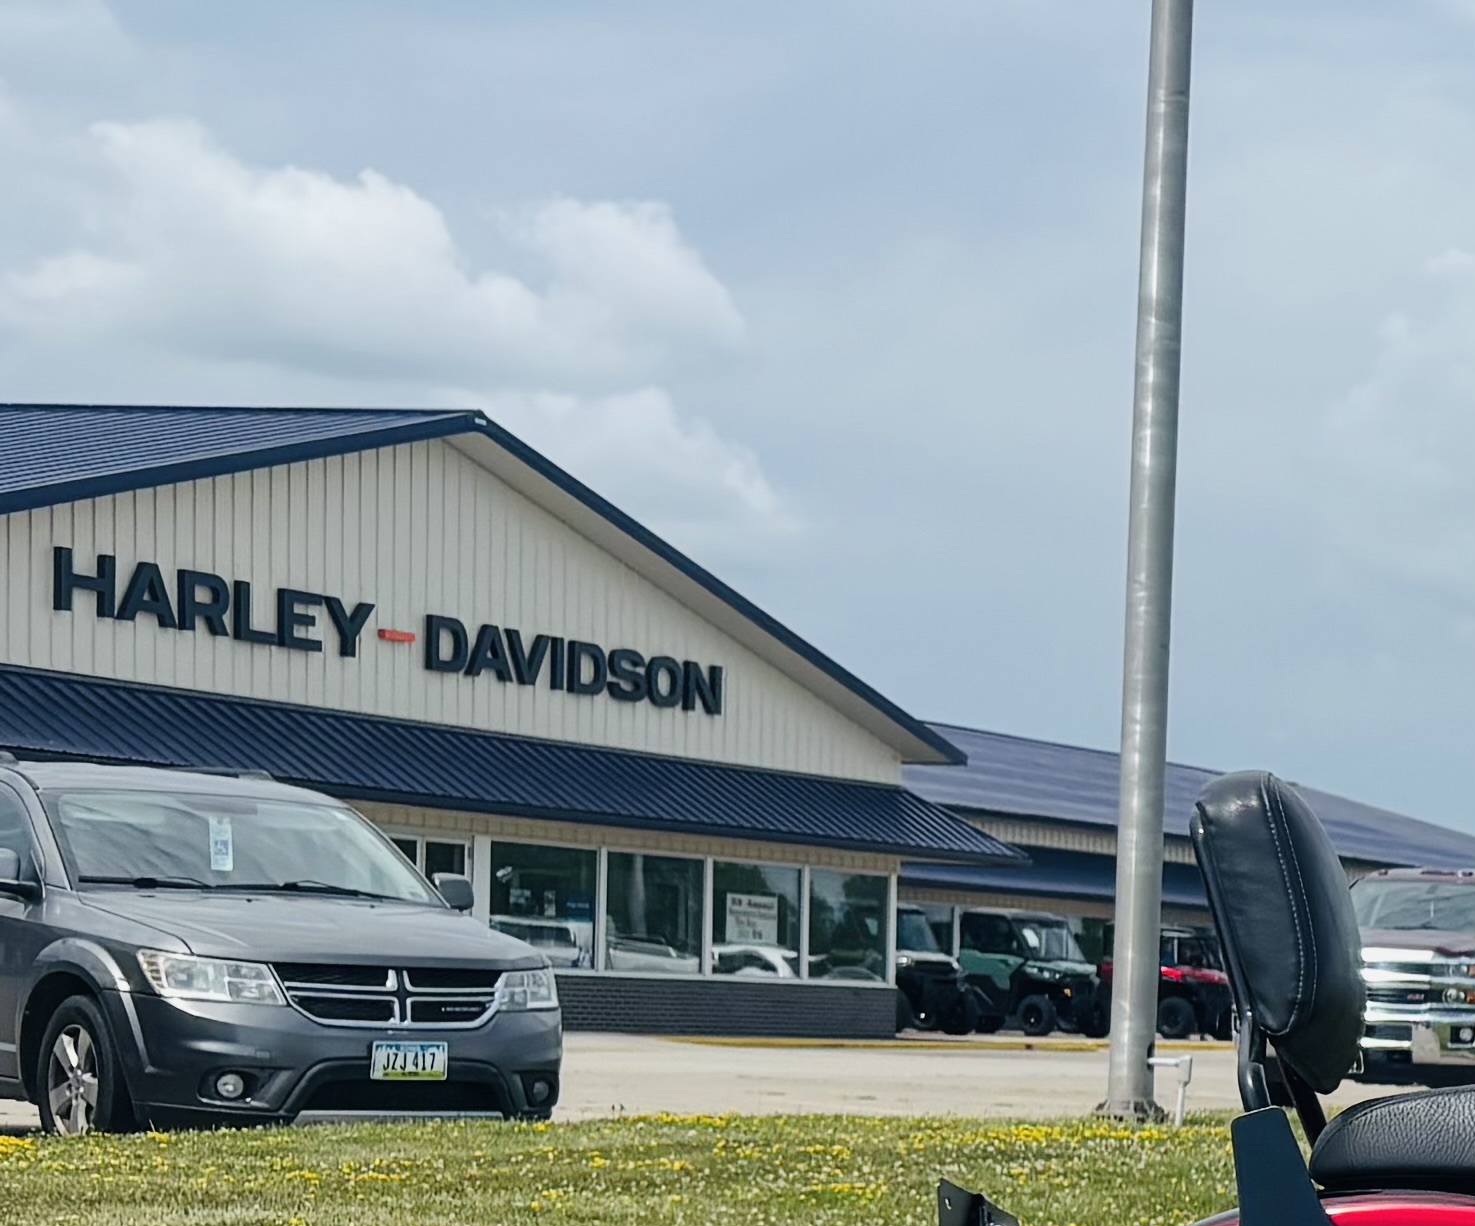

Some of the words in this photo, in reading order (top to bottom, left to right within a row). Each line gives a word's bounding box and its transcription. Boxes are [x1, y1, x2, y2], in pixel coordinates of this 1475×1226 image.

[53, 546, 725, 717] HARLEY-DAVIDSON
[383, 1052, 407, 1071] JZJ
[412, 1052, 436, 1071] 417
